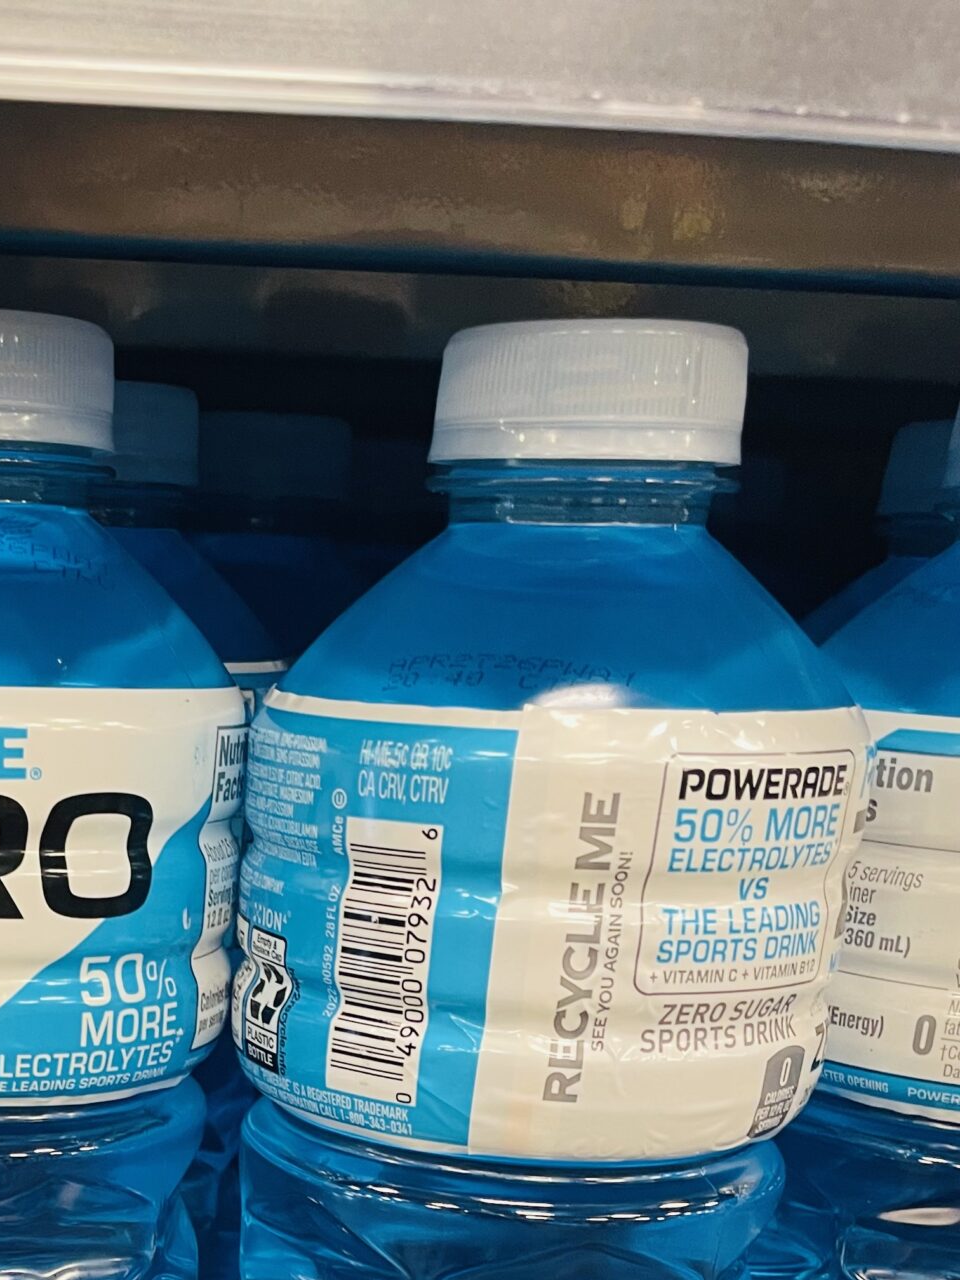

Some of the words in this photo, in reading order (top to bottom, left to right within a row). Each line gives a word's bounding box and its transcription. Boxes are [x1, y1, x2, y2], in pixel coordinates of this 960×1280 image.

[358, 770, 376, 797] CA
[409, 775, 449, 804] CTRV
[679, 764, 848, 801] POWERADE
[422, 828, 438, 840] 6
[673, 808, 753, 842] 50%
[765, 804, 840, 841] MORE
[667, 843, 831, 873] ELECTROLYTES
[610, 851, 633, 909] SOON!
[739, 877, 769, 901] VS
[404, 877, 437, 964] 07932
[662, 908, 717, 935] THE
[728, 901, 820, 934] LEADING
[542, 882, 606, 1103] RECYCLE
[574, 791, 621, 871] ME
[604, 914, 622, 973] AGAIN
[656, 937, 758, 963] SPORTS
[764, 931, 818, 960] DRINK
[79, 953, 177, 1007] 50%
[663, 969, 725, 985] VITAMIN
[729, 968, 738, 982] C
[753, 963, 797, 981] VITAMIN
[799, 959, 816, 974] B12
[599, 977, 615, 1014] YOU
[658, 1002, 727, 1025] ZERO
[729, 994, 797, 1021] SUGAR
[80, 1002, 178, 1047] MORE
[396, 978, 425, 1057] 49000
[592, 1016, 607, 1051] SEE
[640, 1025, 737, 1053] SPORTS
[743, 1016, 797, 1046] DRINK
[247, 1028, 275, 1048] PLASTIC
[248, 1043, 274, 1067] BOTTLE
[12, 1077, 75, 1092] LEADING
[79, 1073, 129, 1089] SPORTS
[779, 1057, 792, 1086] 0
[847, 1075, 889, 1093] OPENING
[354, 1098, 408, 1122] TRADEMARK
